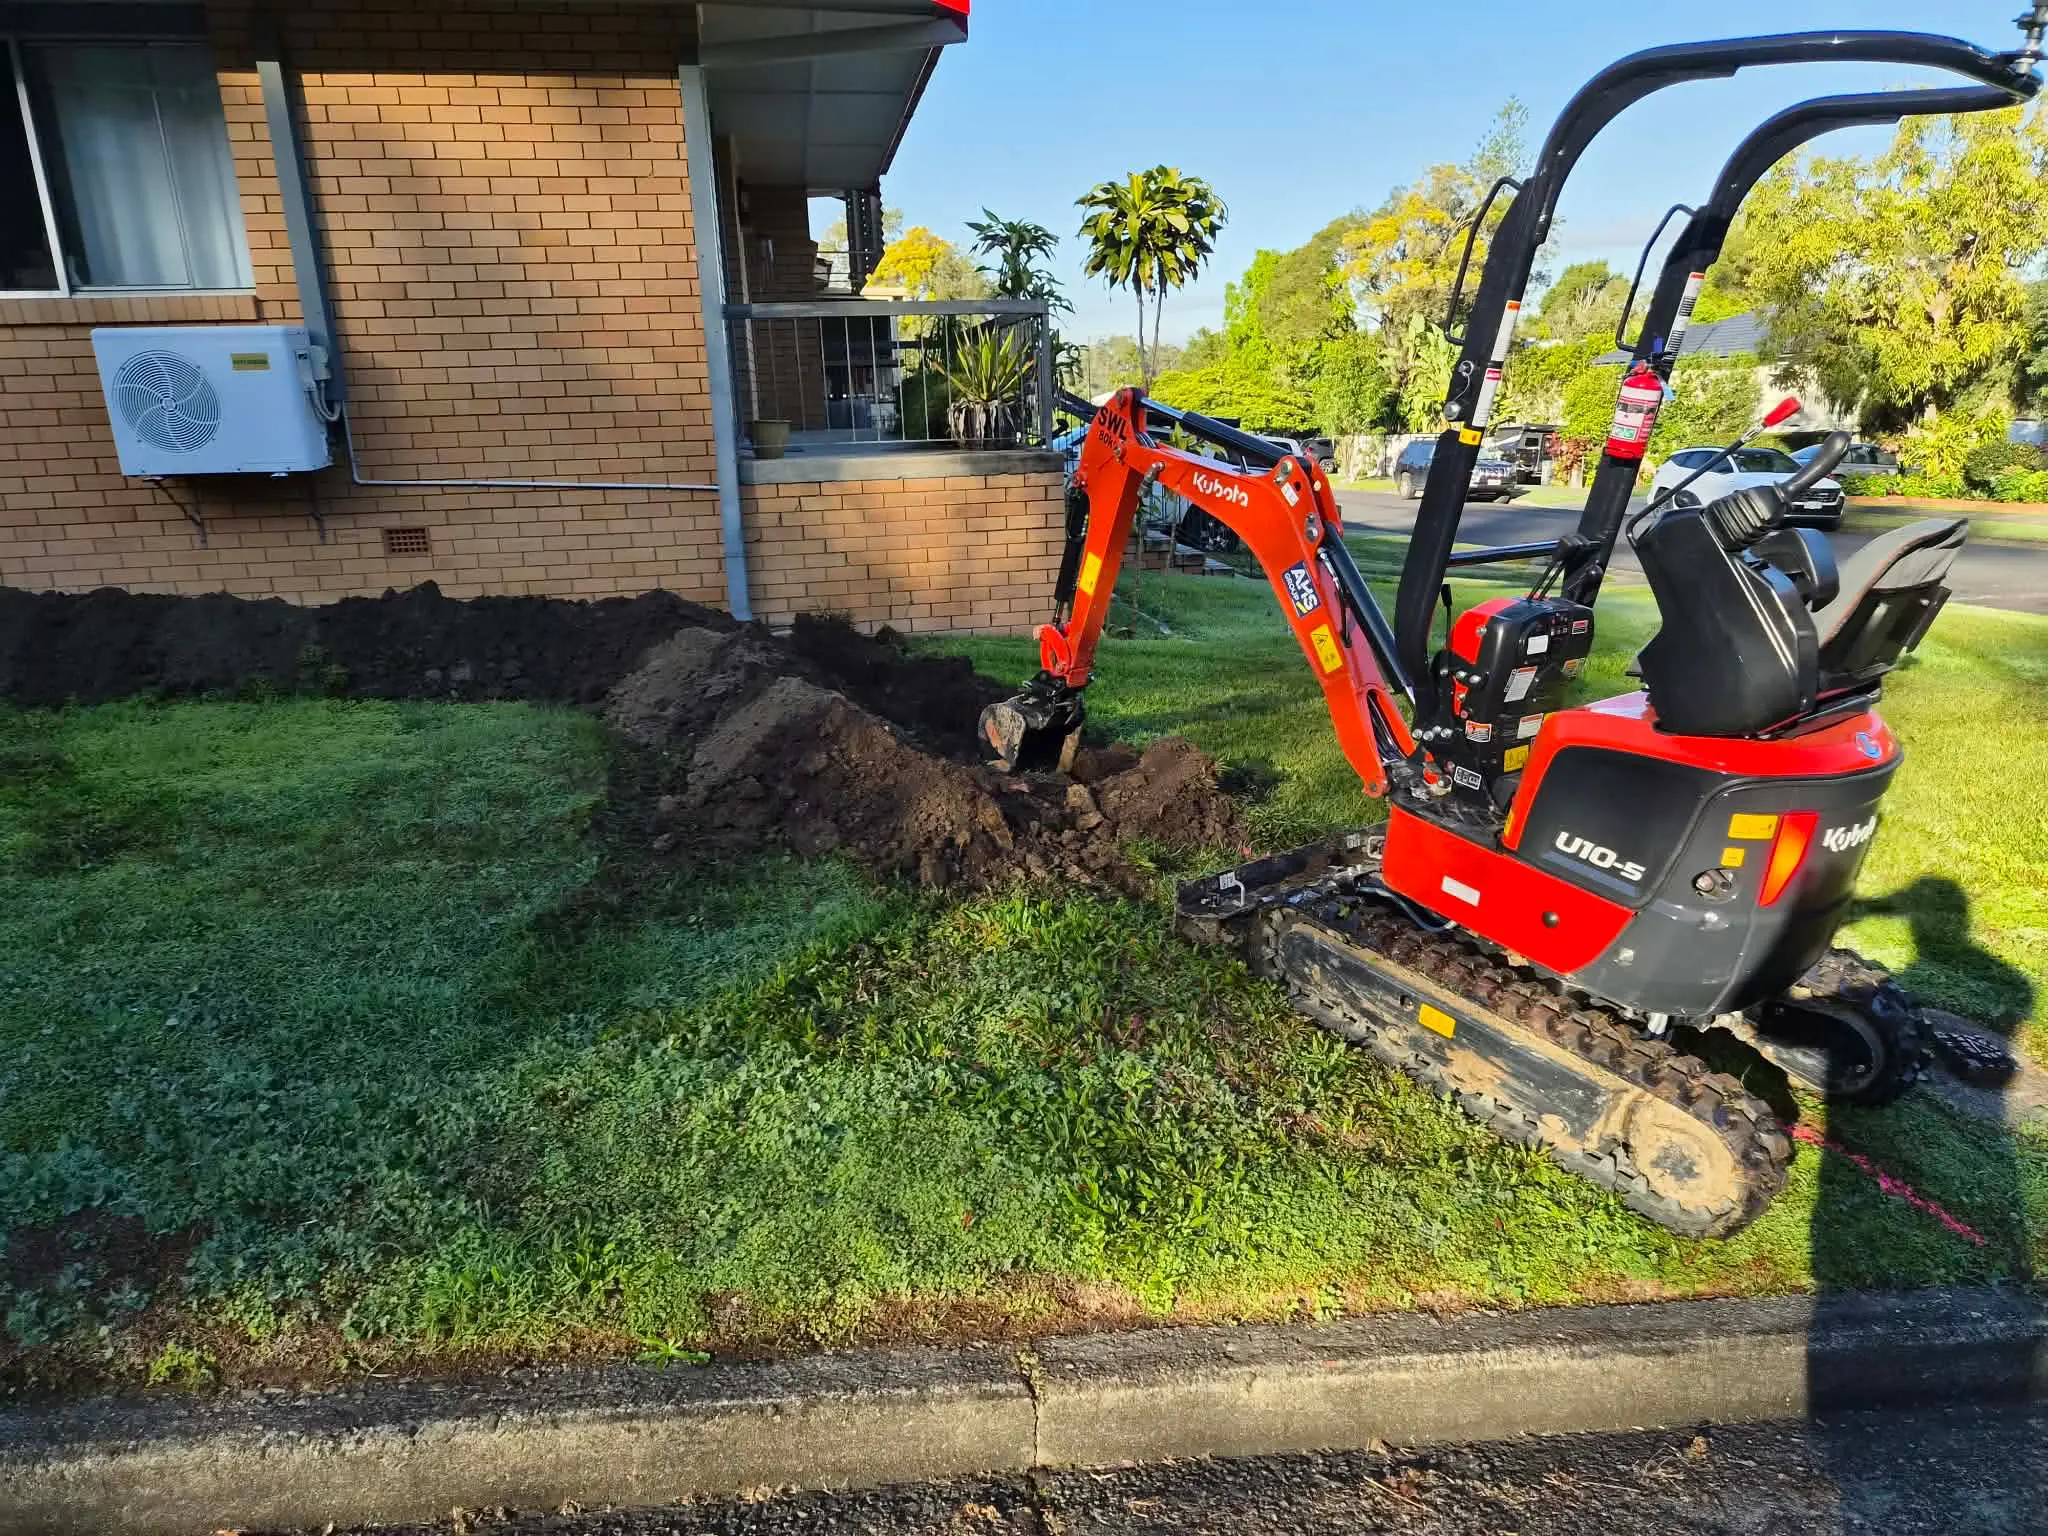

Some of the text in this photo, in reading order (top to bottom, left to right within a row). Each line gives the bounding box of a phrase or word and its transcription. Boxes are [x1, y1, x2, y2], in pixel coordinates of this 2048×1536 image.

[1098, 406, 1127, 441] SWL
[1193, 471, 1249, 507] Kubota
[1284, 572, 1300, 600] GROUP
[1290, 569, 1318, 611] AHS
